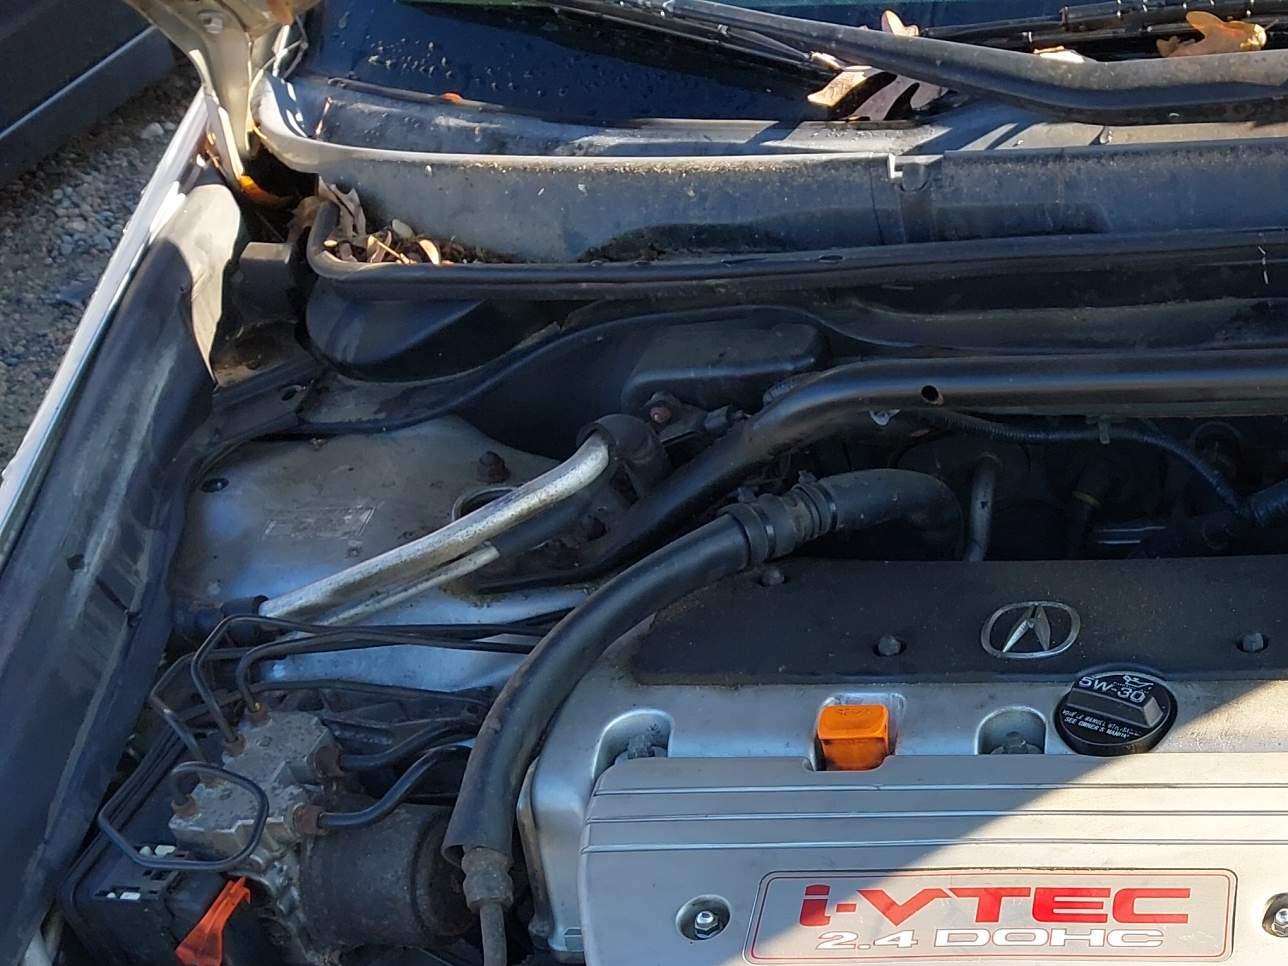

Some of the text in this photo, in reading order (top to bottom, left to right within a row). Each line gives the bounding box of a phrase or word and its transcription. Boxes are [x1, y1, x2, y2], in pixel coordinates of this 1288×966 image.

[1078, 676, 1146, 703] 5W-30
[800, 884, 1191, 927] i-VTEC
[815, 928, 1164, 950] 2.4 DOHC
